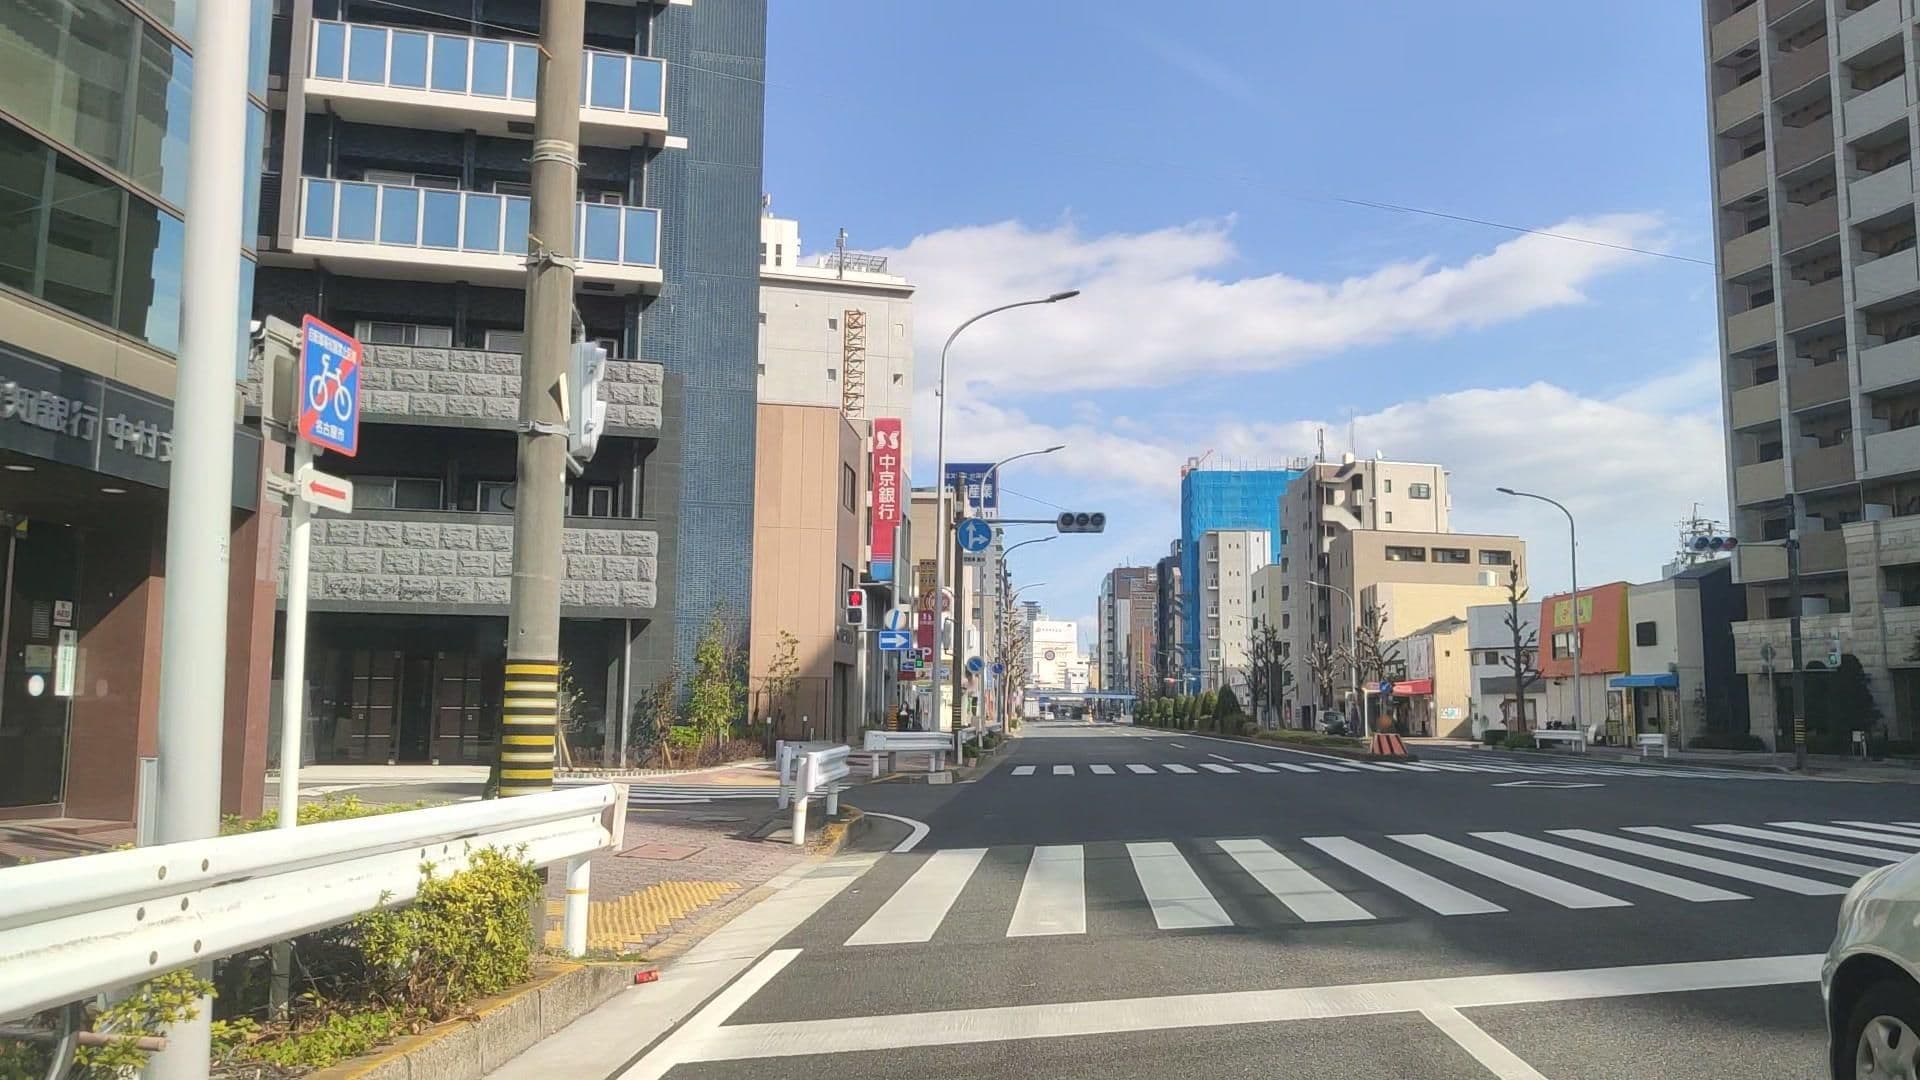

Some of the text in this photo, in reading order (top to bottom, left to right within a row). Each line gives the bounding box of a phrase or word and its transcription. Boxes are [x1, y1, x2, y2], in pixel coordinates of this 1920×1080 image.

[315, 419, 345, 442] 名古屋市
[878, 454, 896, 520] 中京銀行
